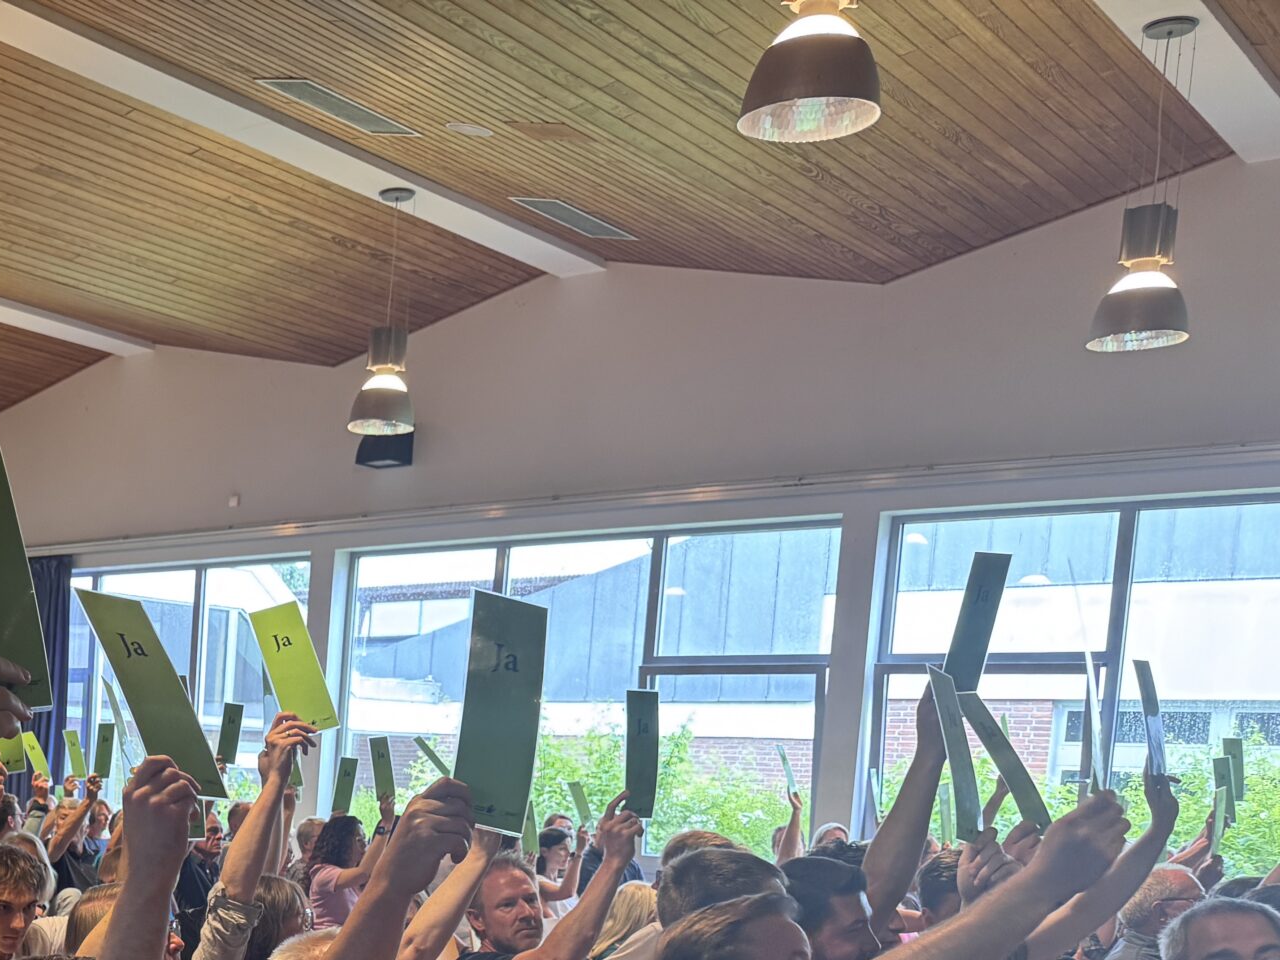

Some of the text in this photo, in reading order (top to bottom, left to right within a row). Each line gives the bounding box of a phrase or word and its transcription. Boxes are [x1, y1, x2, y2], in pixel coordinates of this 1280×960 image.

[116, 632, 148, 658] Ja
[272, 633, 293, 653] Ja
[491, 643, 519, 672] Ja
[637, 717, 649, 736] Ja
